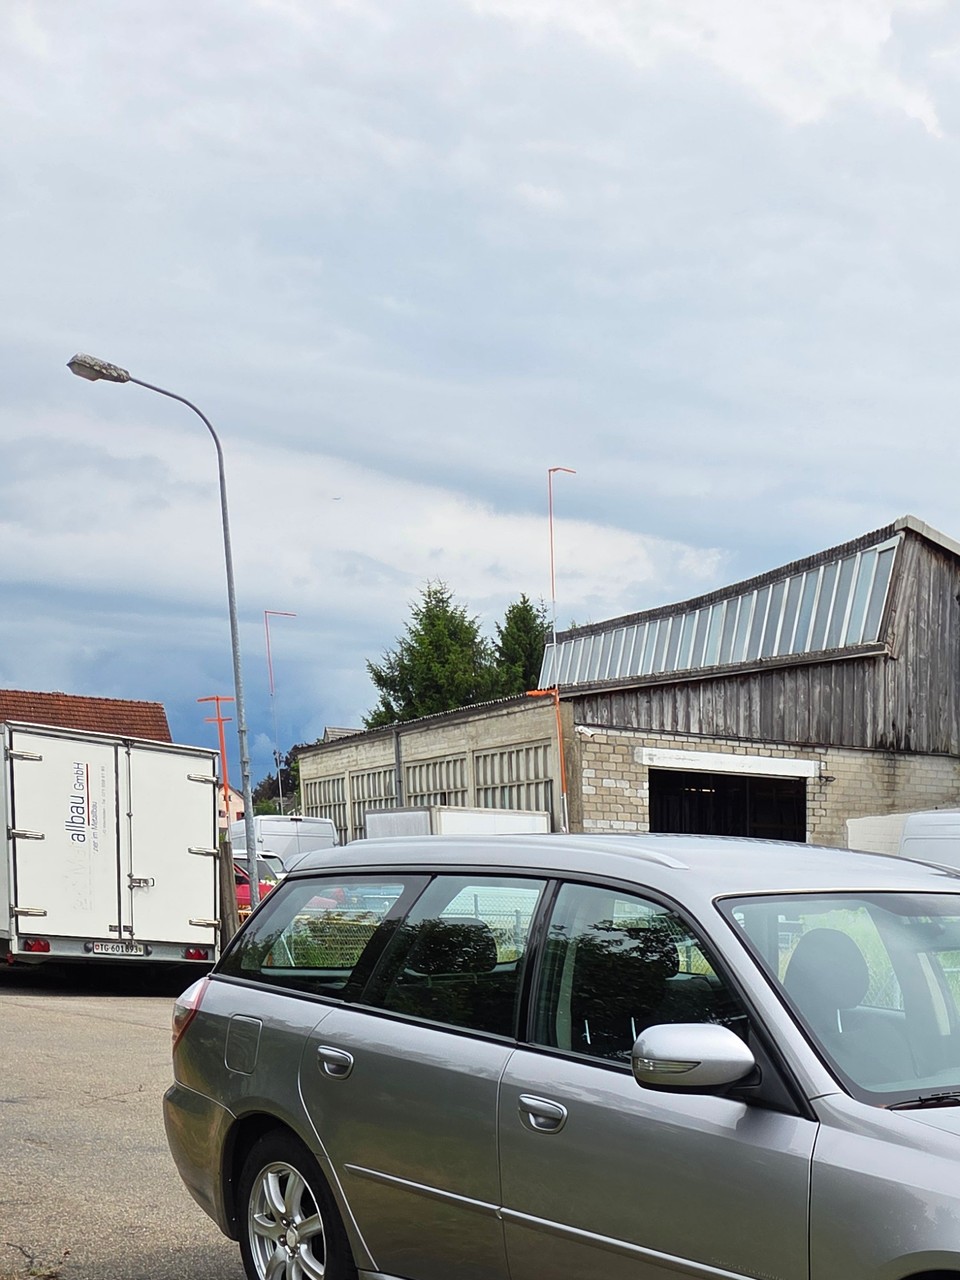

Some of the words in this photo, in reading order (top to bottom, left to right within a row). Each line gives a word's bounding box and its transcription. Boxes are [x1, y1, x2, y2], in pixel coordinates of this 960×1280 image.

[73, 762, 84, 791] GmbH
[65, 795, 86, 843] allbau
[90, 801, 98, 830] Metallbau
